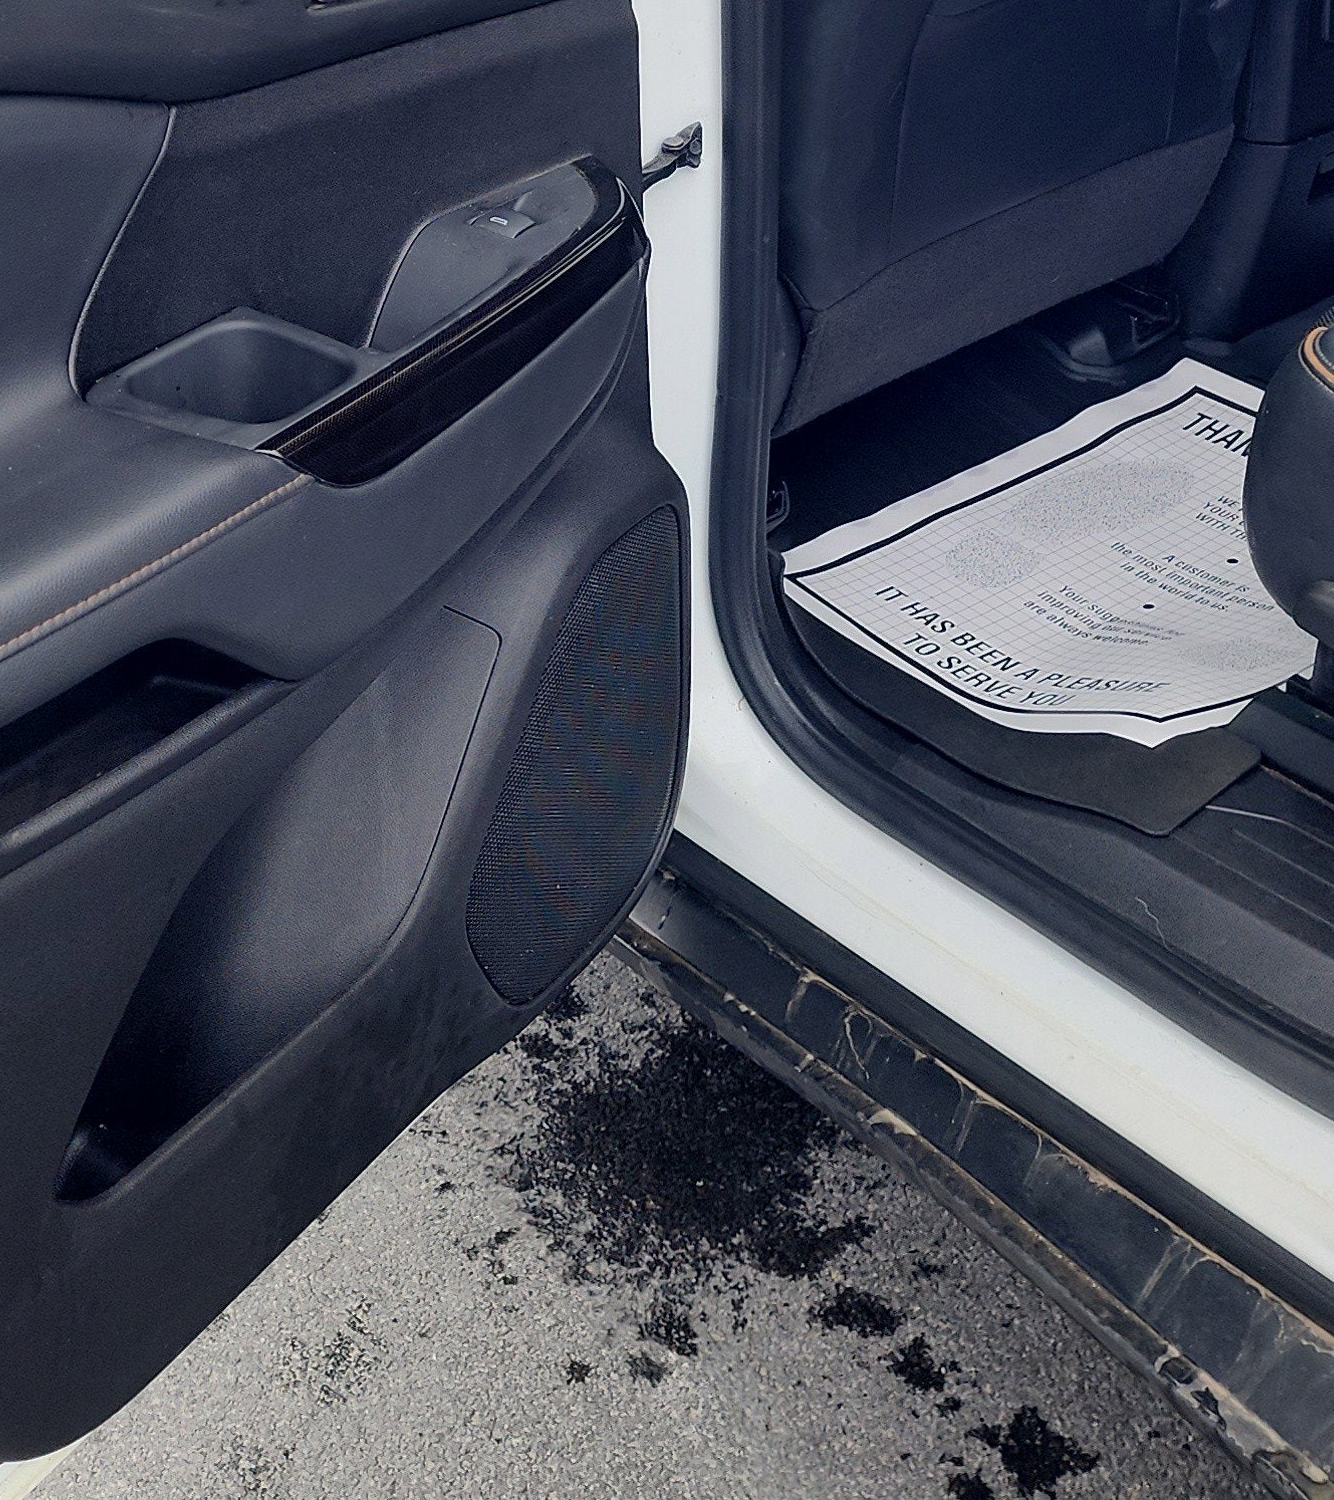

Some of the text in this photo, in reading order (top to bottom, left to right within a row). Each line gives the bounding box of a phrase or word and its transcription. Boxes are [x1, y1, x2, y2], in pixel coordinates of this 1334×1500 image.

[1182, 412, 1253, 457] THAN
[1195, 512, 1230, 531] WITH
[1203, 502, 1239, 522] YOUR
[1218, 496, 1240, 508] WE
[1111, 542, 1275, 612] the most important person
[1120, 561, 1135, 573] in
[1135, 570, 1157, 584] the
[1159, 582, 1198, 601] world
[1195, 596, 1210, 606] to
[1161, 555, 1250, 592] A customer is
[1037, 590, 1102, 631] improving
[1059, 585, 1089, 605] Your
[875, 585, 1171, 693] IT HAS BEEN A PLEASURE
[1023, 600, 1046, 616] are
[1046, 613, 1093, 639] always
[903, 632, 1077, 707] TO SERVE YOU
